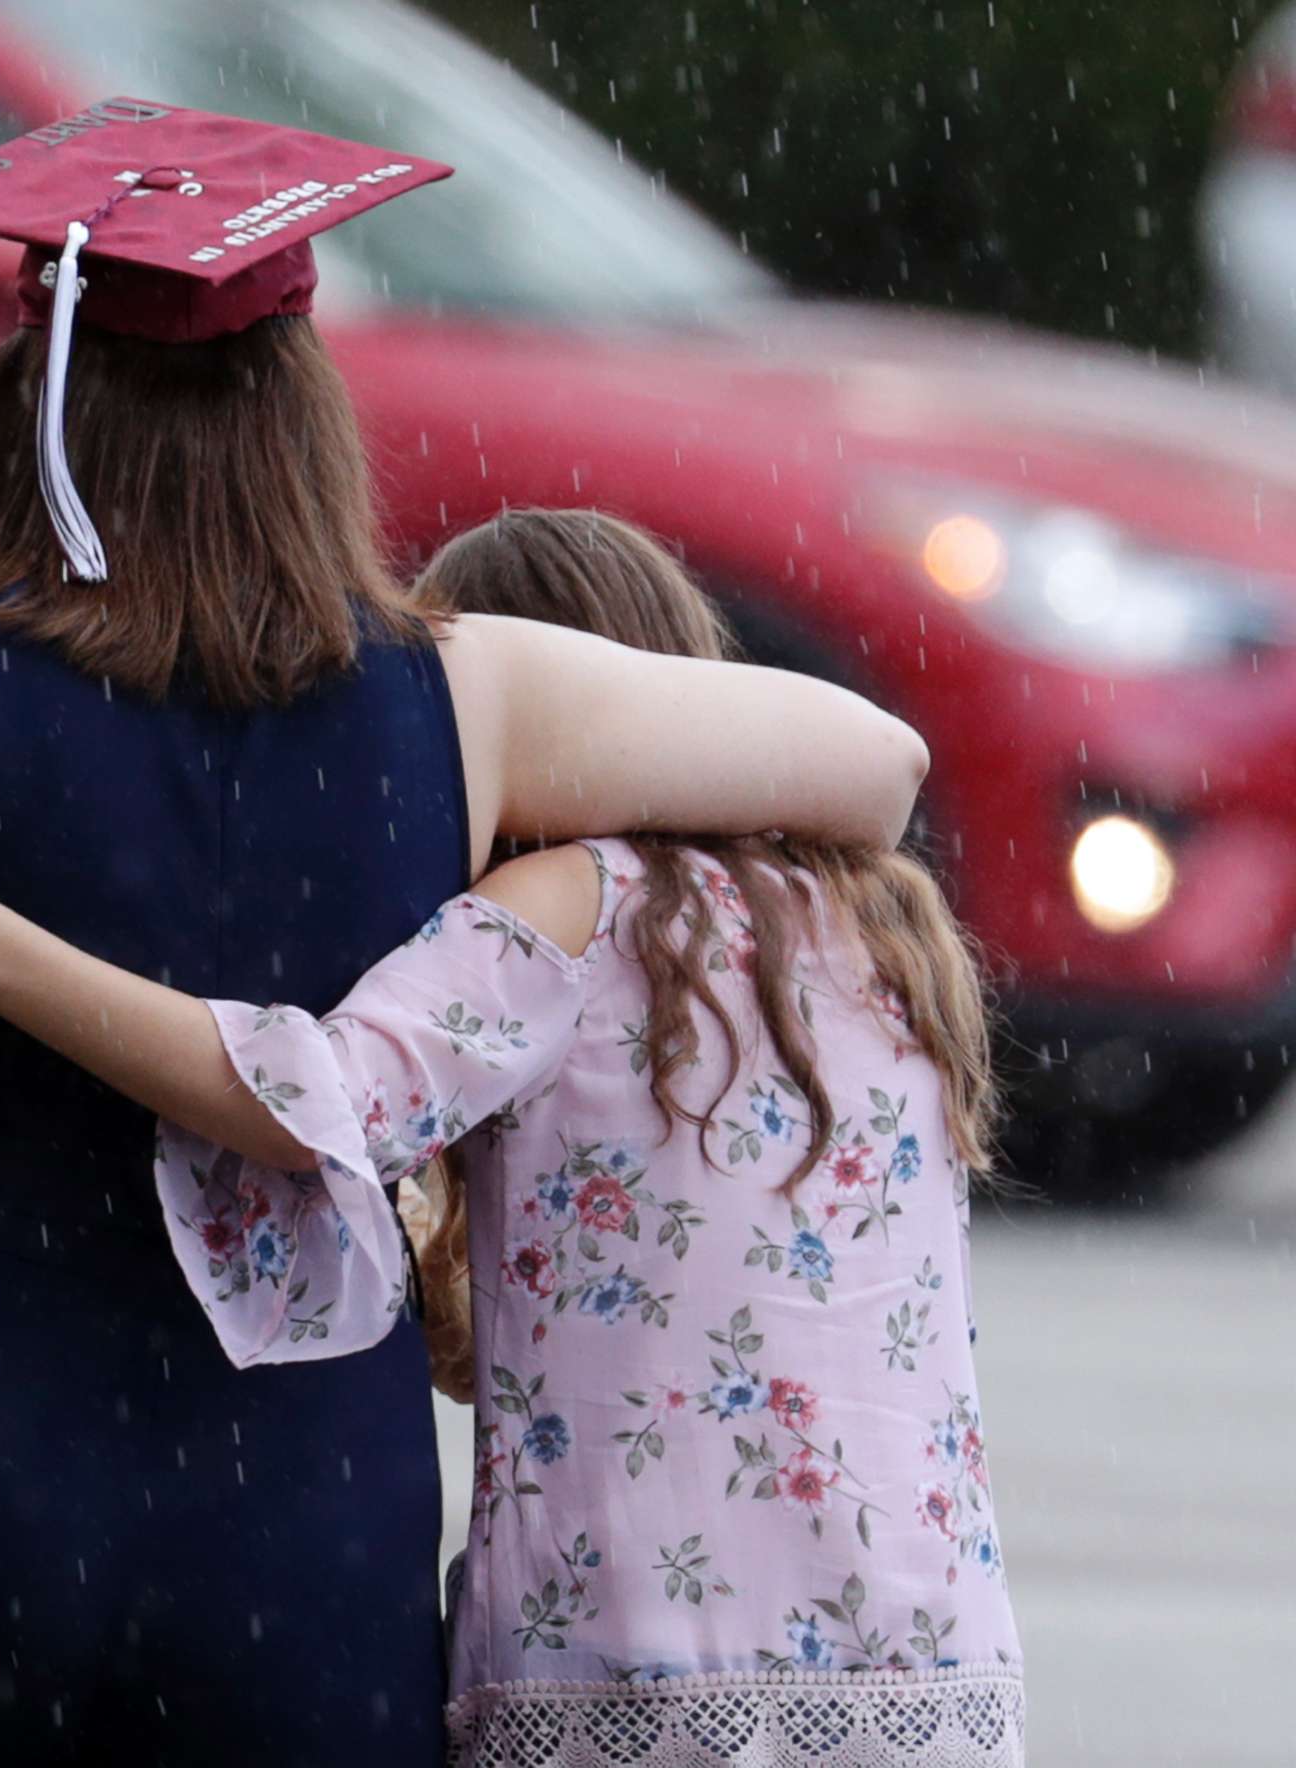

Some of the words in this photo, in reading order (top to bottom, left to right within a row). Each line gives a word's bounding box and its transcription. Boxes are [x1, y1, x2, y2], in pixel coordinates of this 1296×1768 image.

[356, 164, 413, 184] VOX
[223, 180, 328, 229] DESERTO
[223, 183, 357, 247] CLAMANTIS
[189, 246, 225, 262] IN
